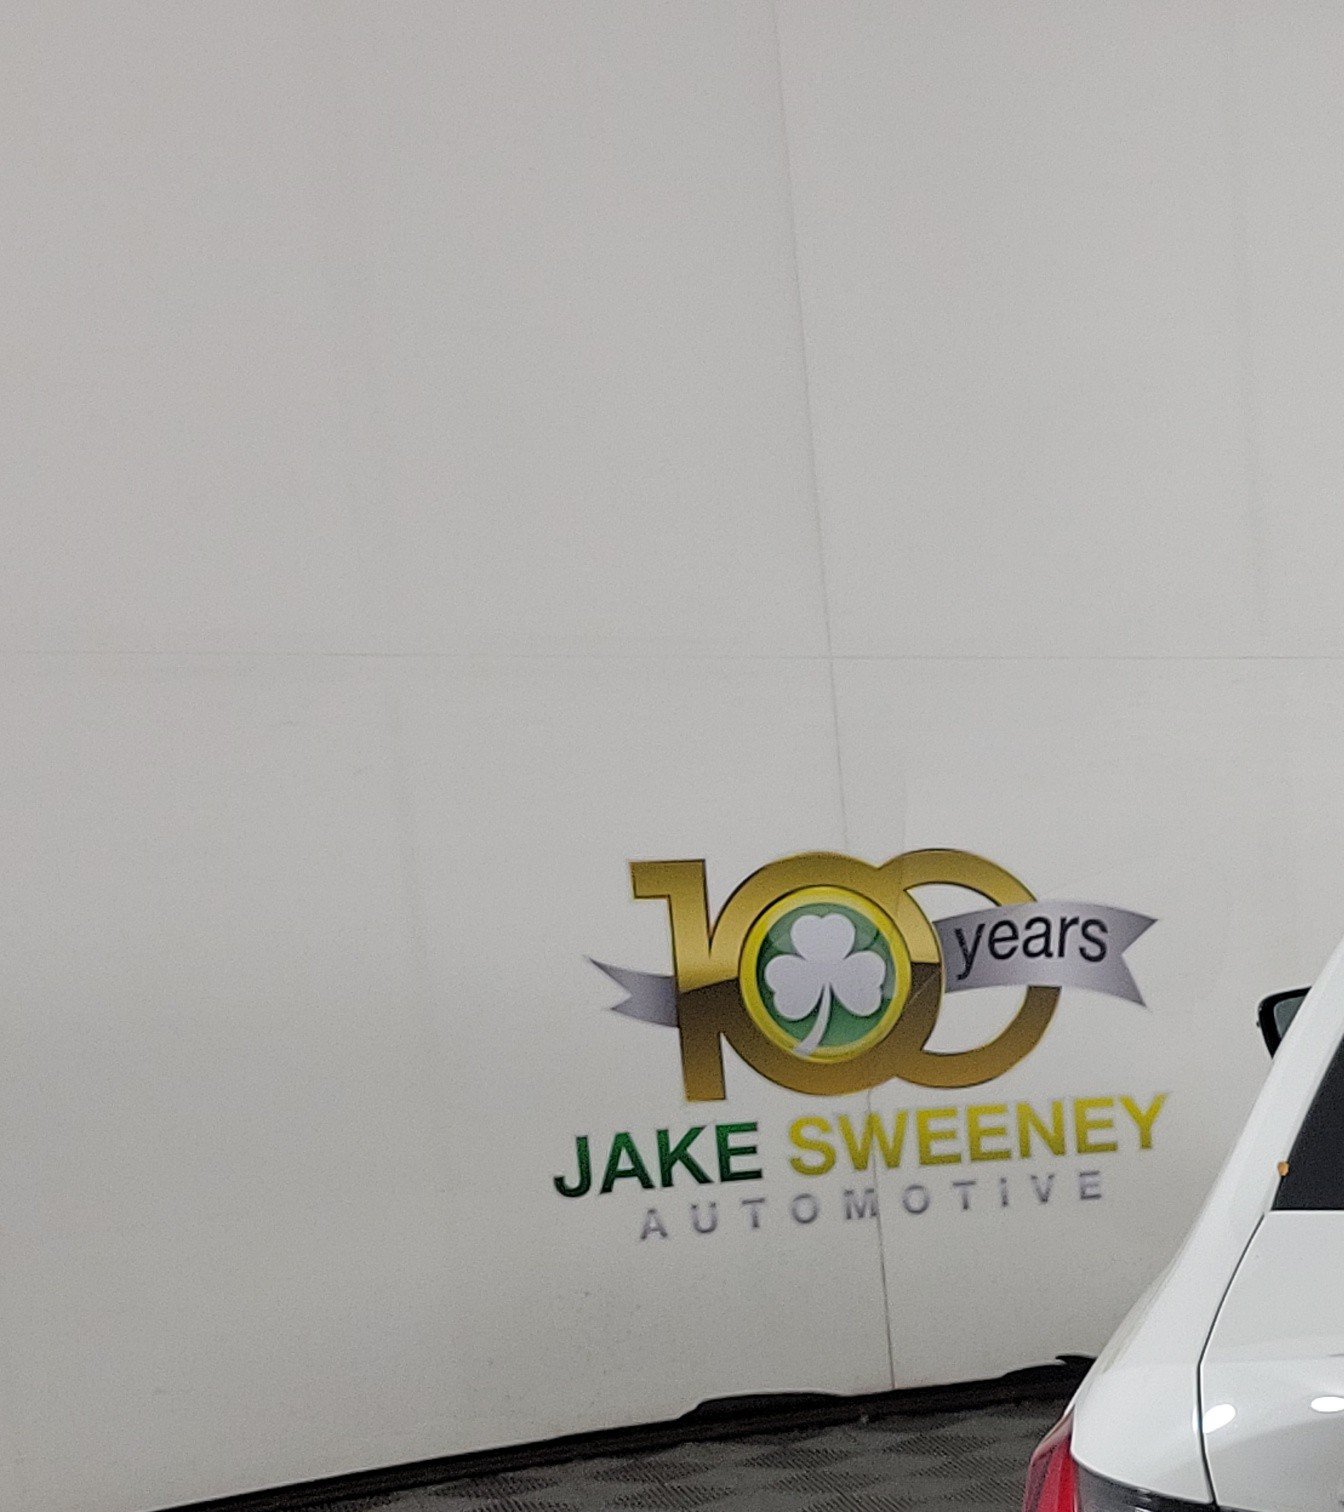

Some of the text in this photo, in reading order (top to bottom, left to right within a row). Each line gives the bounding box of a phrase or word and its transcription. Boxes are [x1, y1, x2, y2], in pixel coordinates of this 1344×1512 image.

[953, 914, 1109, 980] years
[553, 1093, 1169, 1198] JAKE SWEENEY
[640, 1172, 1102, 1240] AUTOMOTIVE
